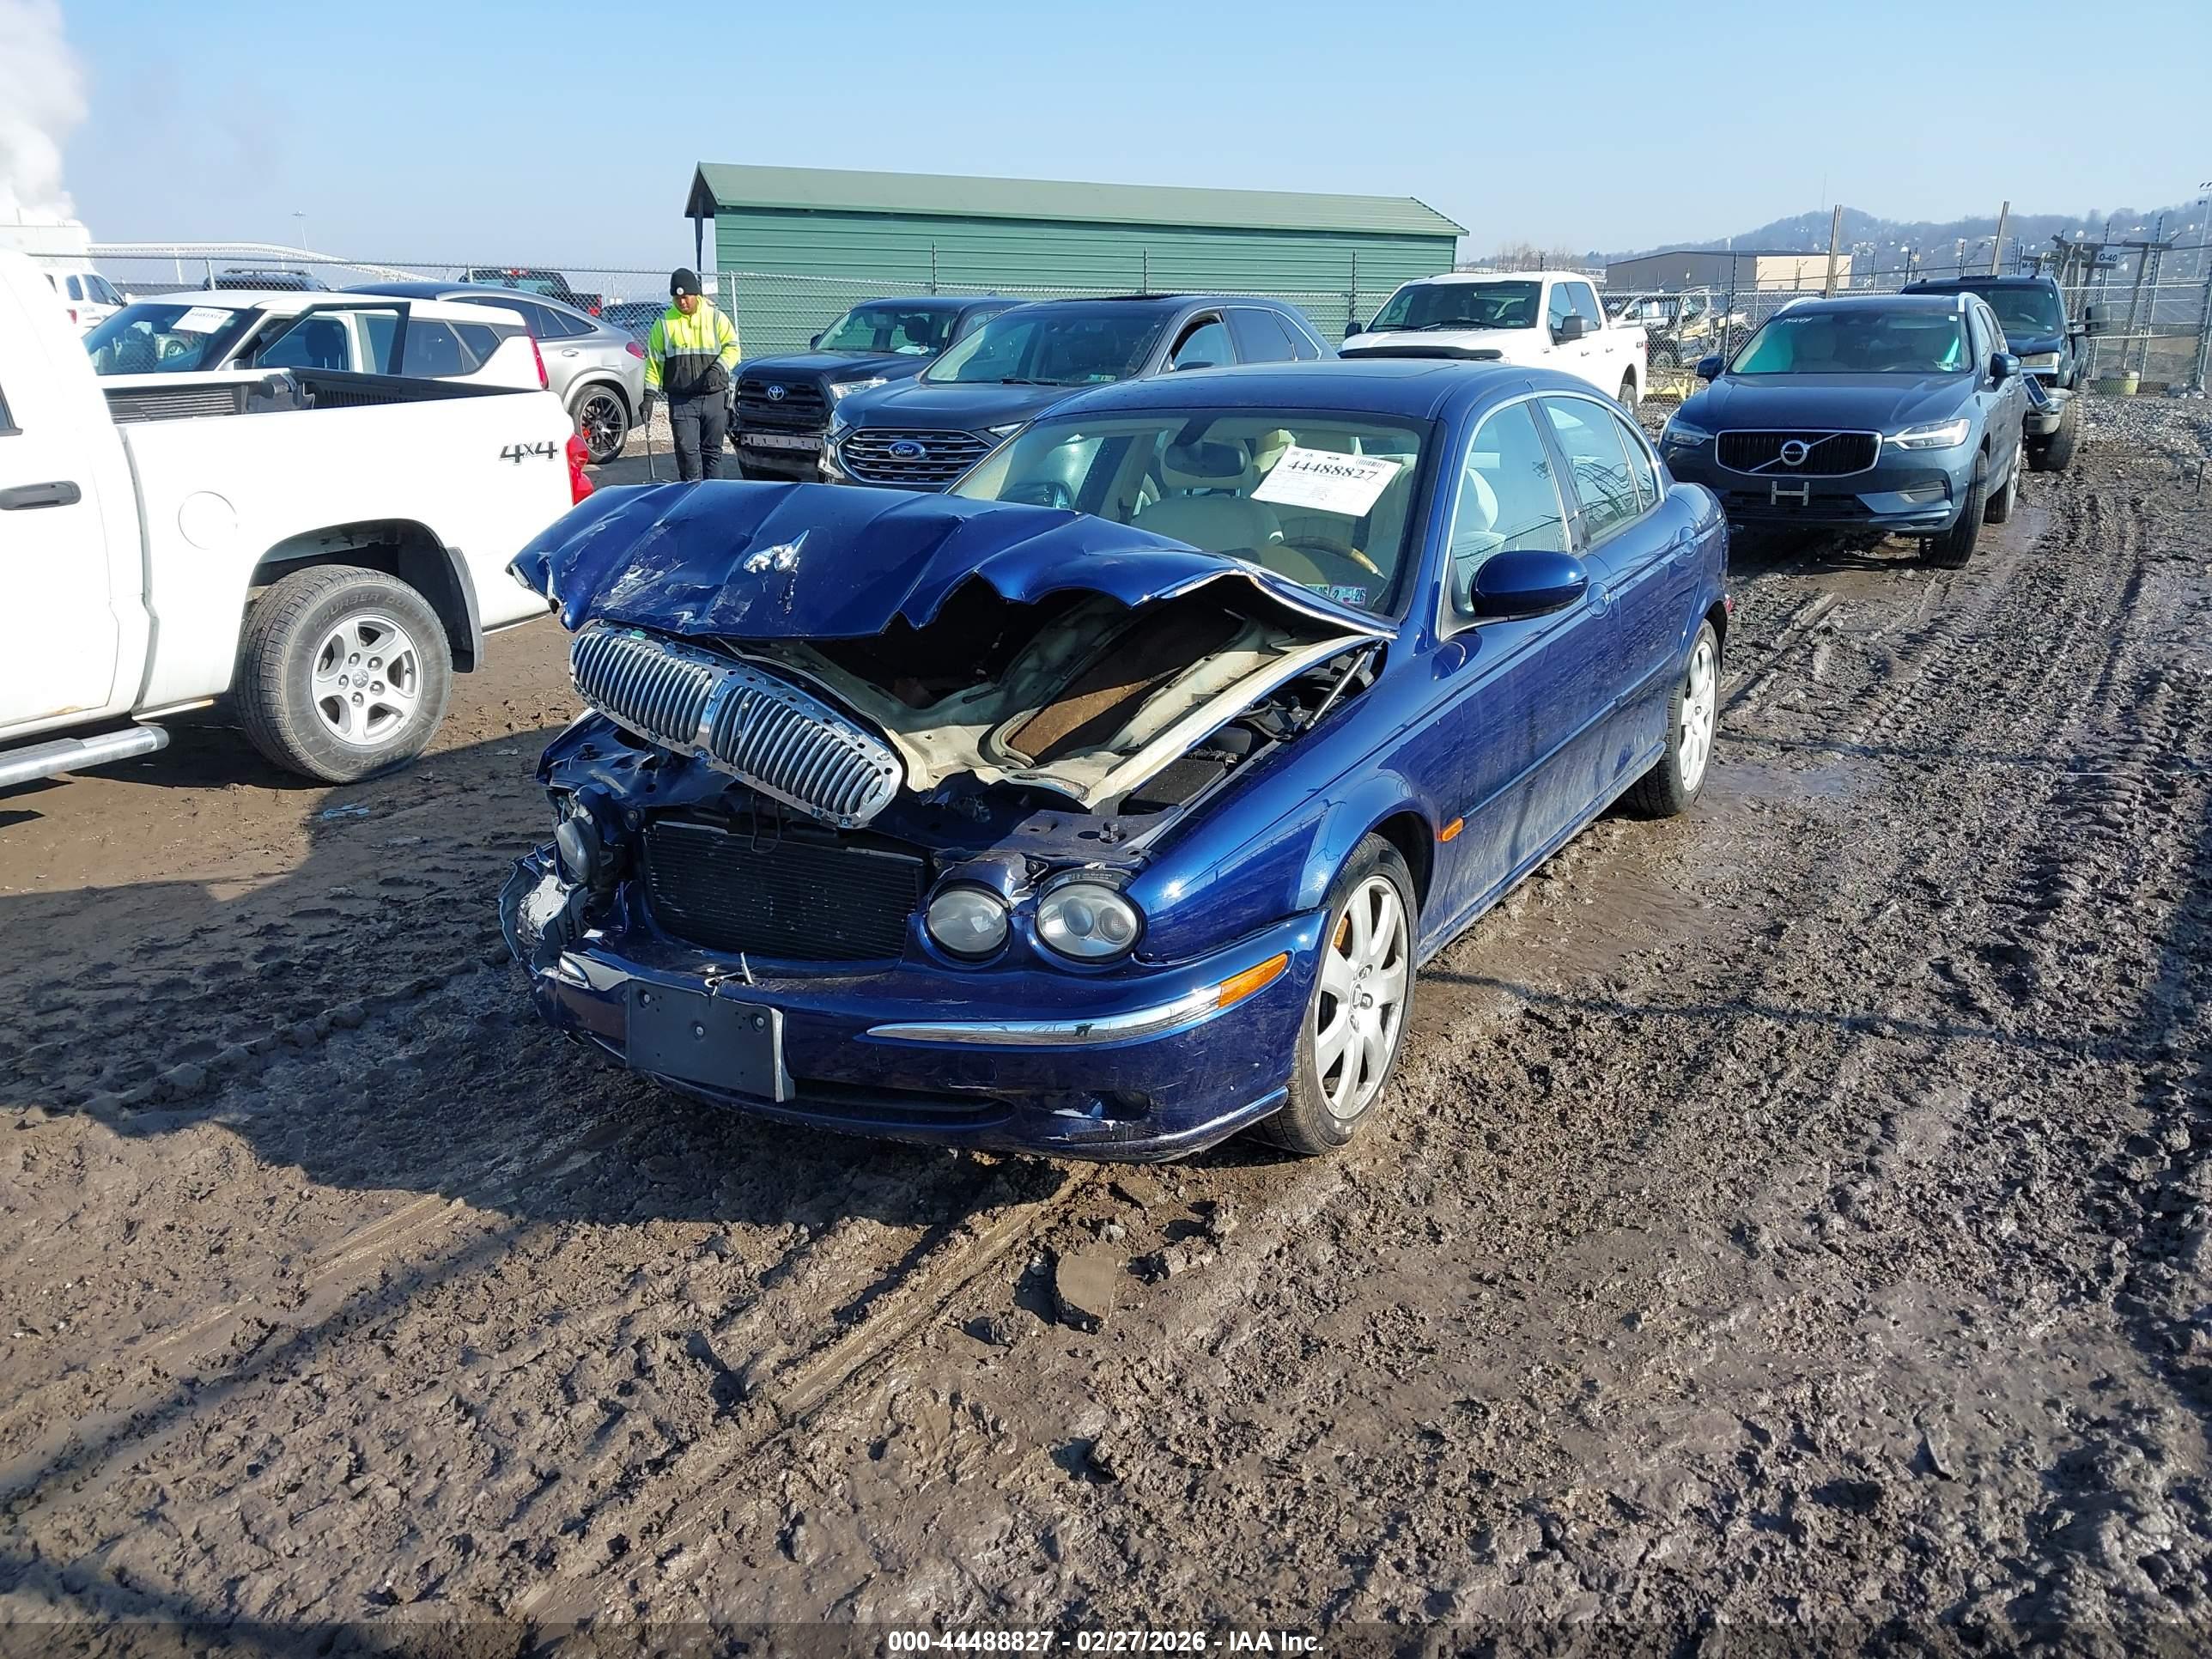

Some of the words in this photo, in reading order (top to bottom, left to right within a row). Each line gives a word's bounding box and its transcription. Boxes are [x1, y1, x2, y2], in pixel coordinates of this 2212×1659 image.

[2098, 253, 2118, 262] O-40
[895, 446, 915, 455] Ford
[1287, 460, 1378, 481] 44488827
